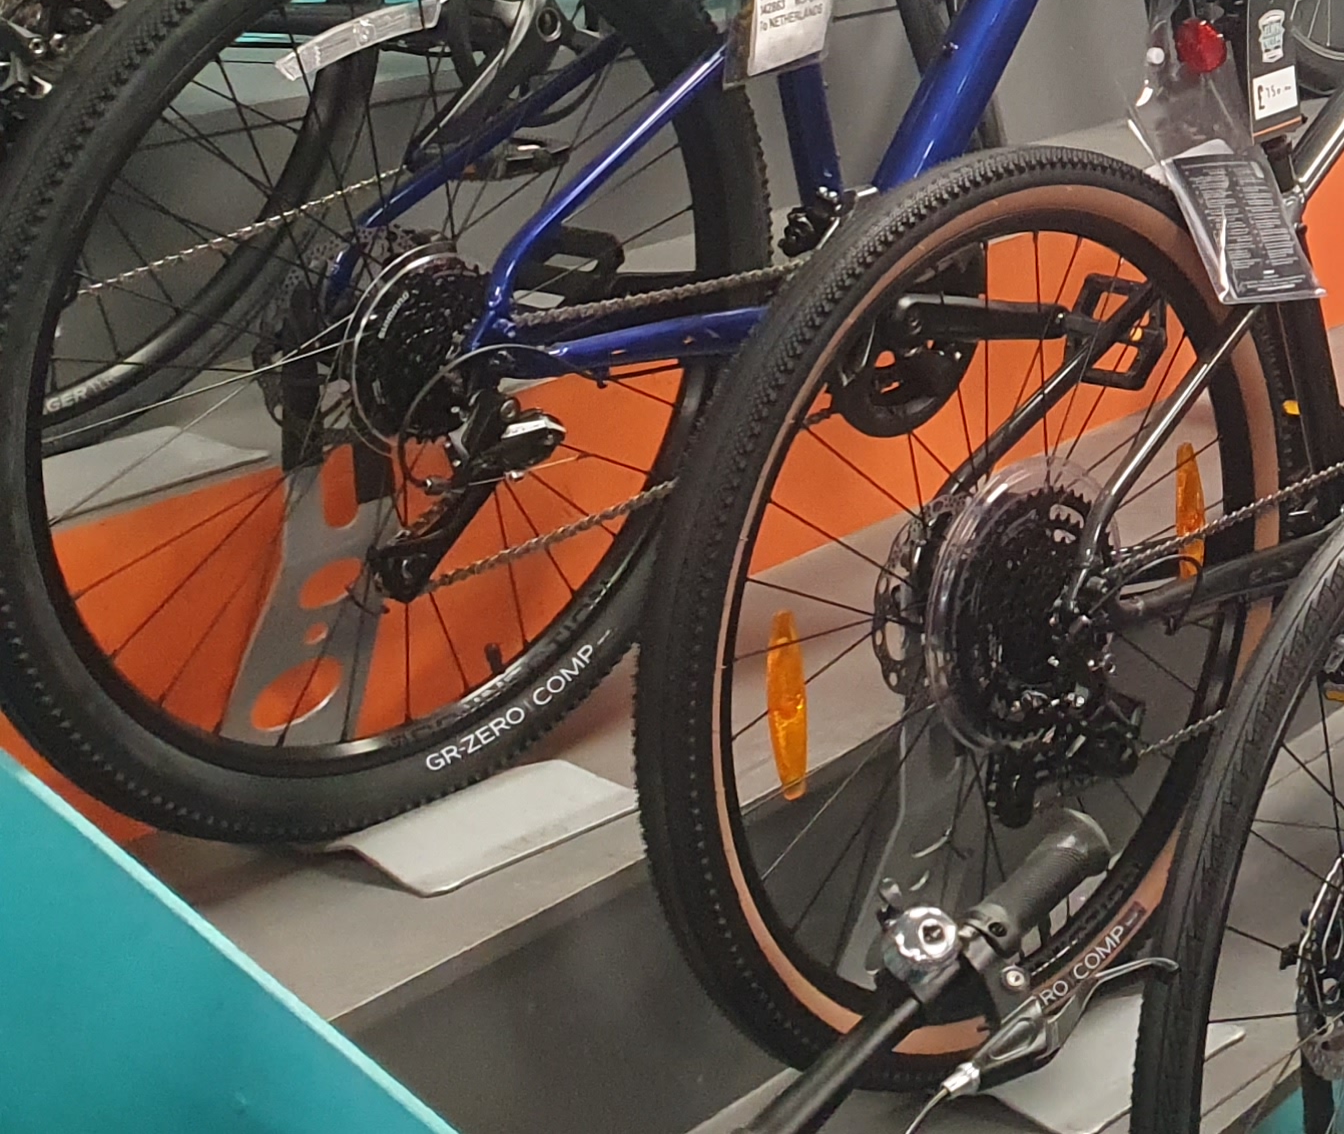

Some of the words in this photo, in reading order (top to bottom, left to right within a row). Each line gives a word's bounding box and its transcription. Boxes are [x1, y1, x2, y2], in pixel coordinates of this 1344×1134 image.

[768, 3, 824, 29] NETHERLANDS
[426, 706, 526, 771] GR-ZERO
[532, 644, 594, 705] COMP
[1073, 925, 1125, 980] COMP
